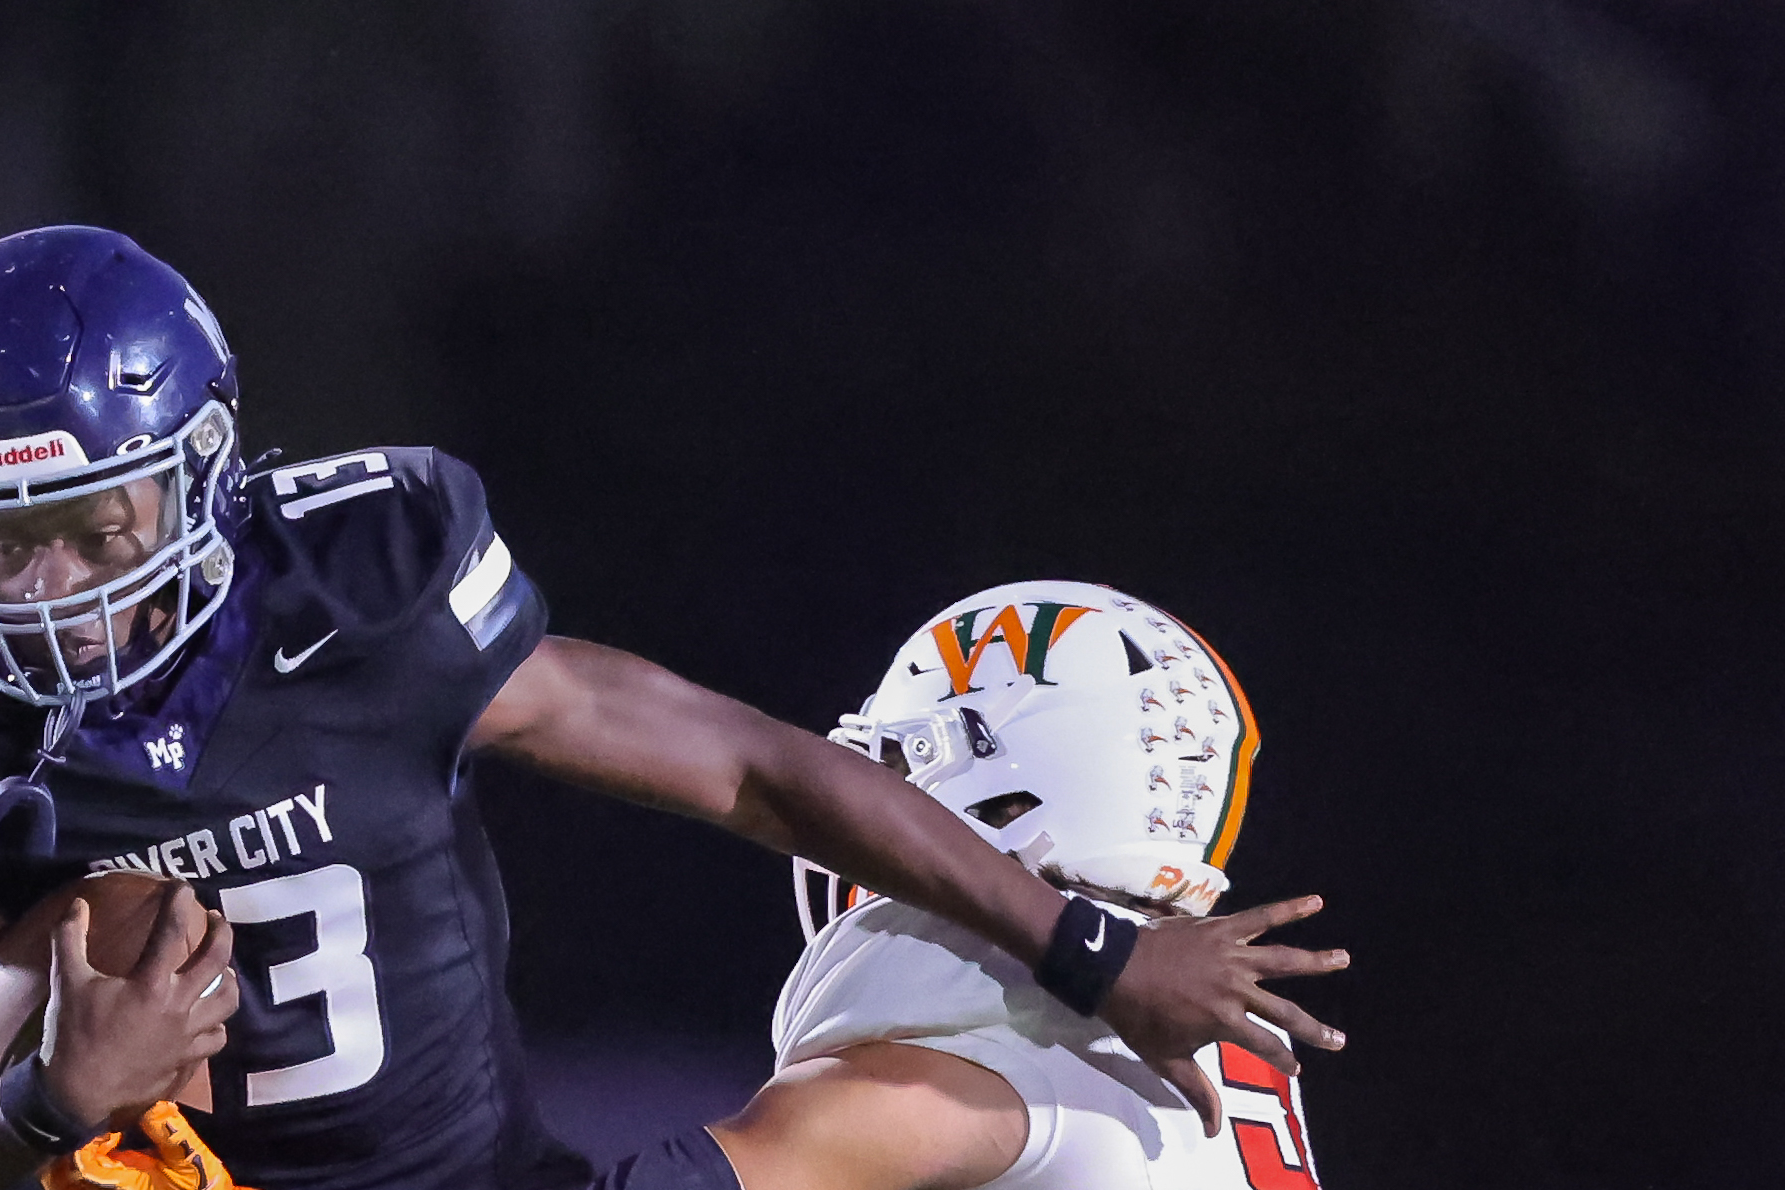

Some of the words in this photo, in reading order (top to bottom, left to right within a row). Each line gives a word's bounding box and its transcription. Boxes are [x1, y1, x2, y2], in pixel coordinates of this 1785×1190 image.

[271, 452, 395, 520] 13
[229, 783, 334, 870] CITY
[218, 862, 386, 1107] 3
